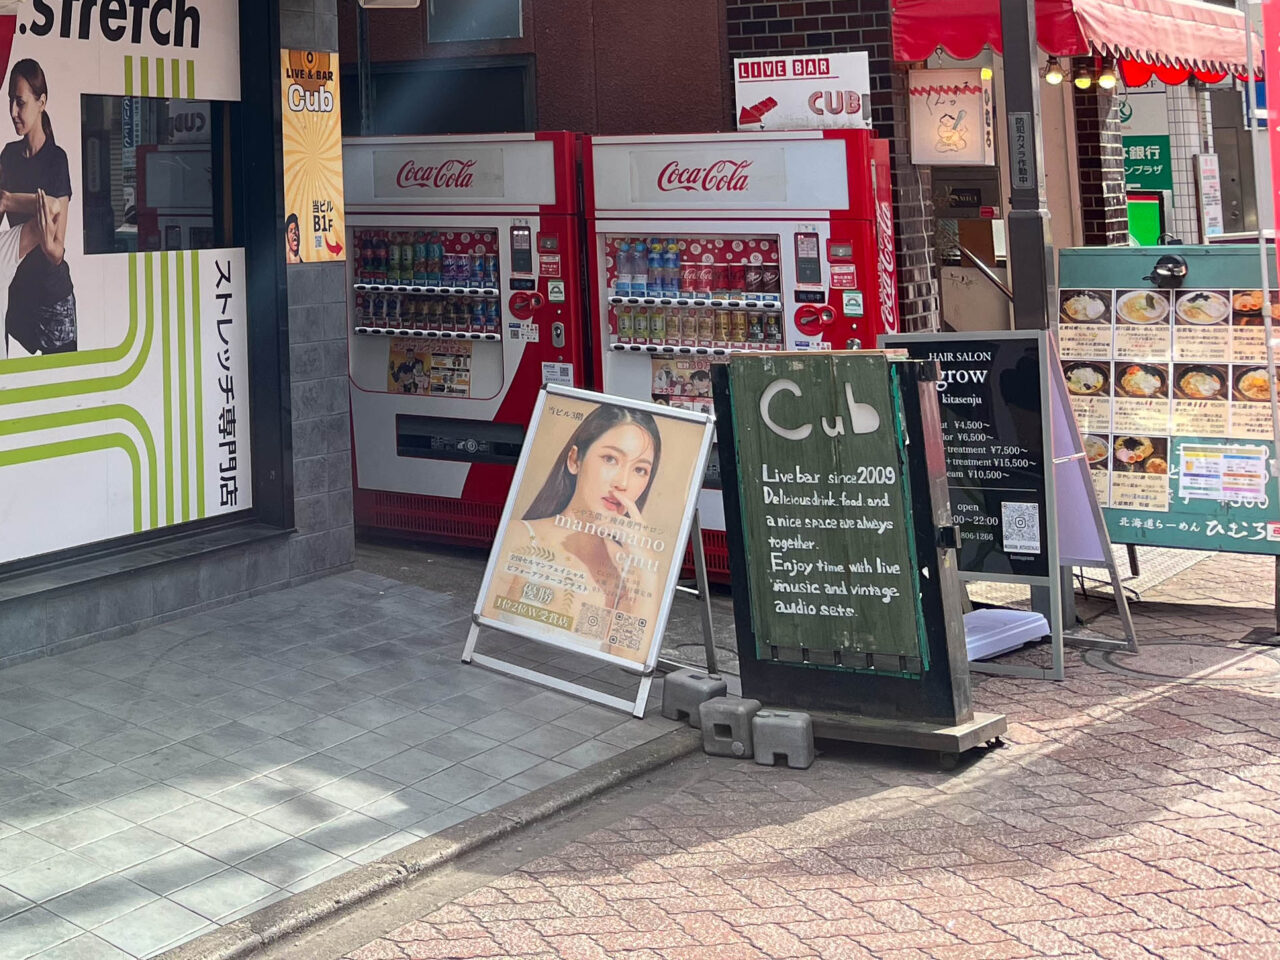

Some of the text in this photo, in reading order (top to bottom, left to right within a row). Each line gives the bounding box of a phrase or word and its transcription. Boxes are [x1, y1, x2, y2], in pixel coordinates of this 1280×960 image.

[286, 68, 334, 82] LIVE & BAR
[739, 58, 830, 79] LIVE BAR
[288, 83, 334, 113] Cub
[807, 90, 862, 116] CUB
[396, 159, 478, 189] Coca-Cola
[657, 159, 754, 192] Coca-Cola
[312, 200, 334, 214] 当ビル
[313, 214, 334, 233] B1F
[928, 351, 992, 361] HAIR SALON
[215, 259, 239, 508] ストレッチ専門店
[935, 369, 988, 391] grow
[759, 378, 881, 441] Cub
[942, 394, 982, 407] kitasenju
[548, 406, 585, 422] 当ビル3階
[762, 463, 896, 485] Live bar since 2009
[763, 485, 811, 506] Delicious
[867, 492, 891, 507] and
[957, 503, 979, 513] open
[554, 512, 665, 553] manomano
[766, 515, 894, 535] a nice space are always
[1119, 516, 1201, 533] 北海道らーめん
[768, 533, 820, 552] together.
[770, 552, 901, 577] Enjoy time with live
[521, 582, 555, 605] 優勝
[773, 580, 900, 603] music and vintage
[774, 598, 817, 615] audio
